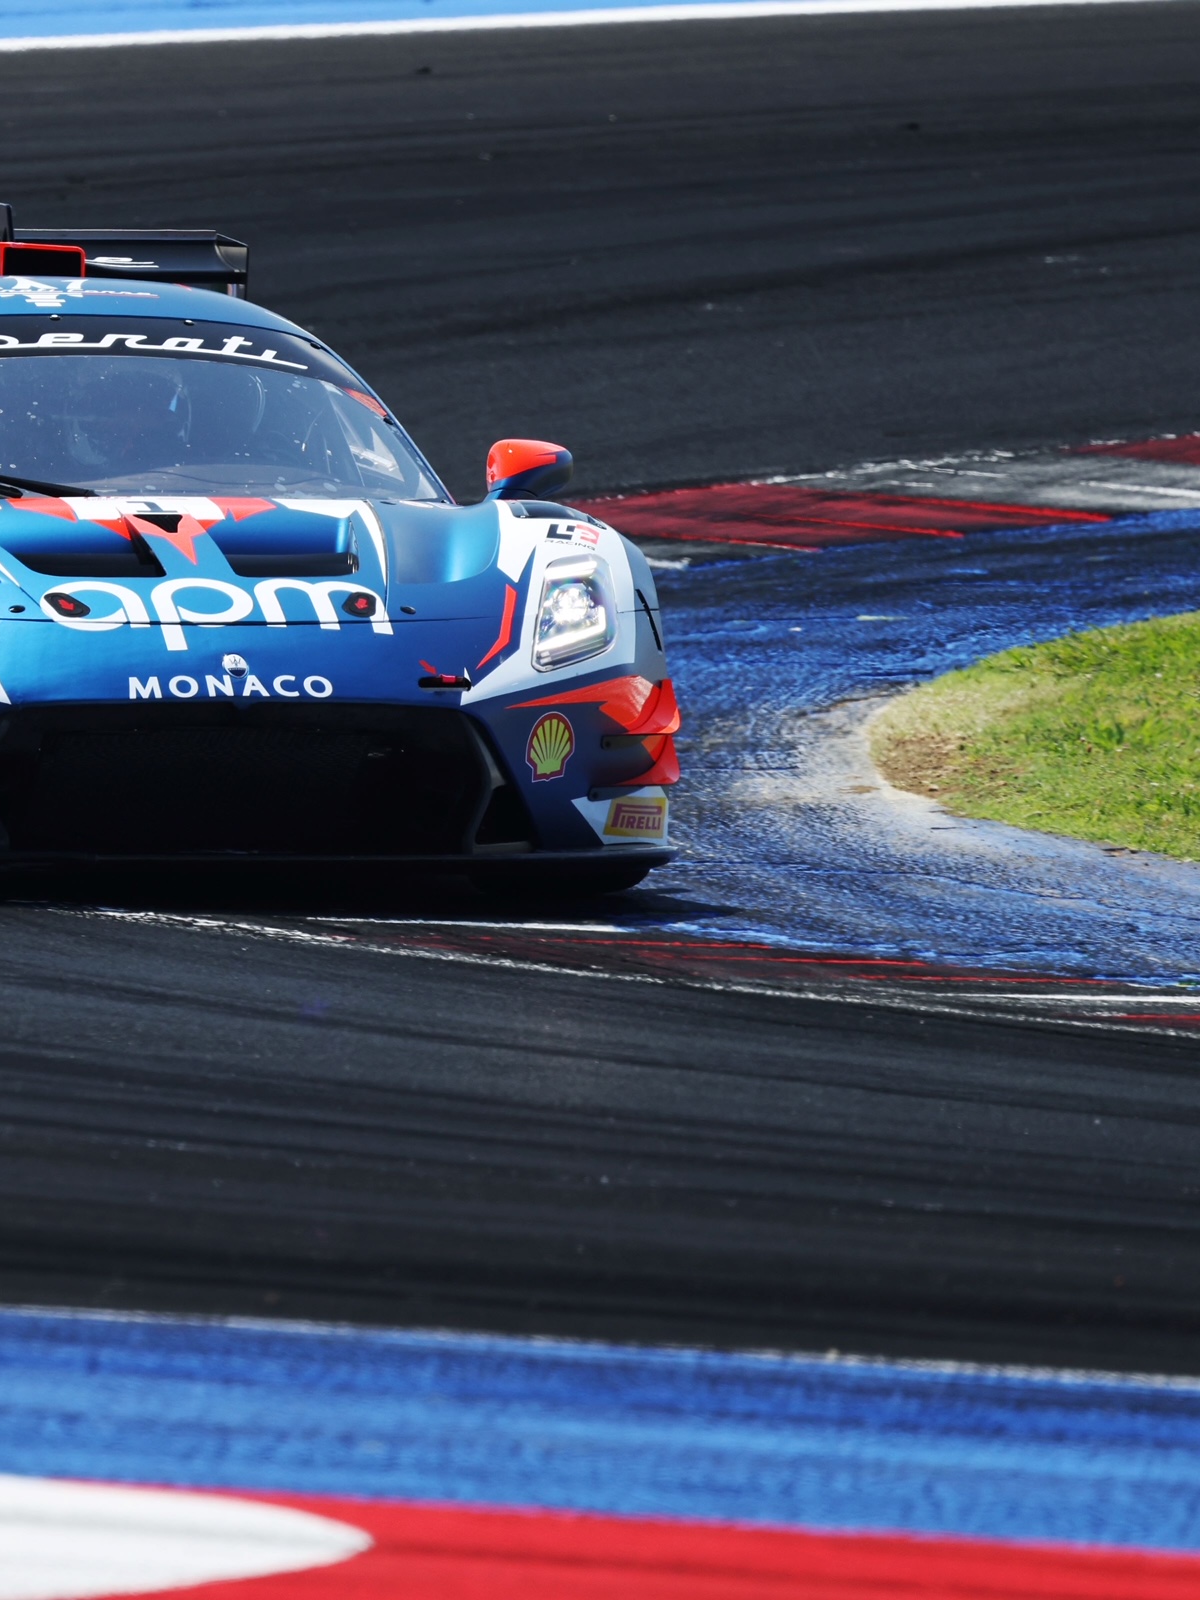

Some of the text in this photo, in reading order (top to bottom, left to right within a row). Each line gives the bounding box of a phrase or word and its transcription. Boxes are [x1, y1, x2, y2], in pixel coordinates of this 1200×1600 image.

[544, 539, 596, 551] RACING
[40, 578, 394, 651] apm
[129, 675, 333, 700] MONACO
[611, 803, 663, 831] PIRELLI
